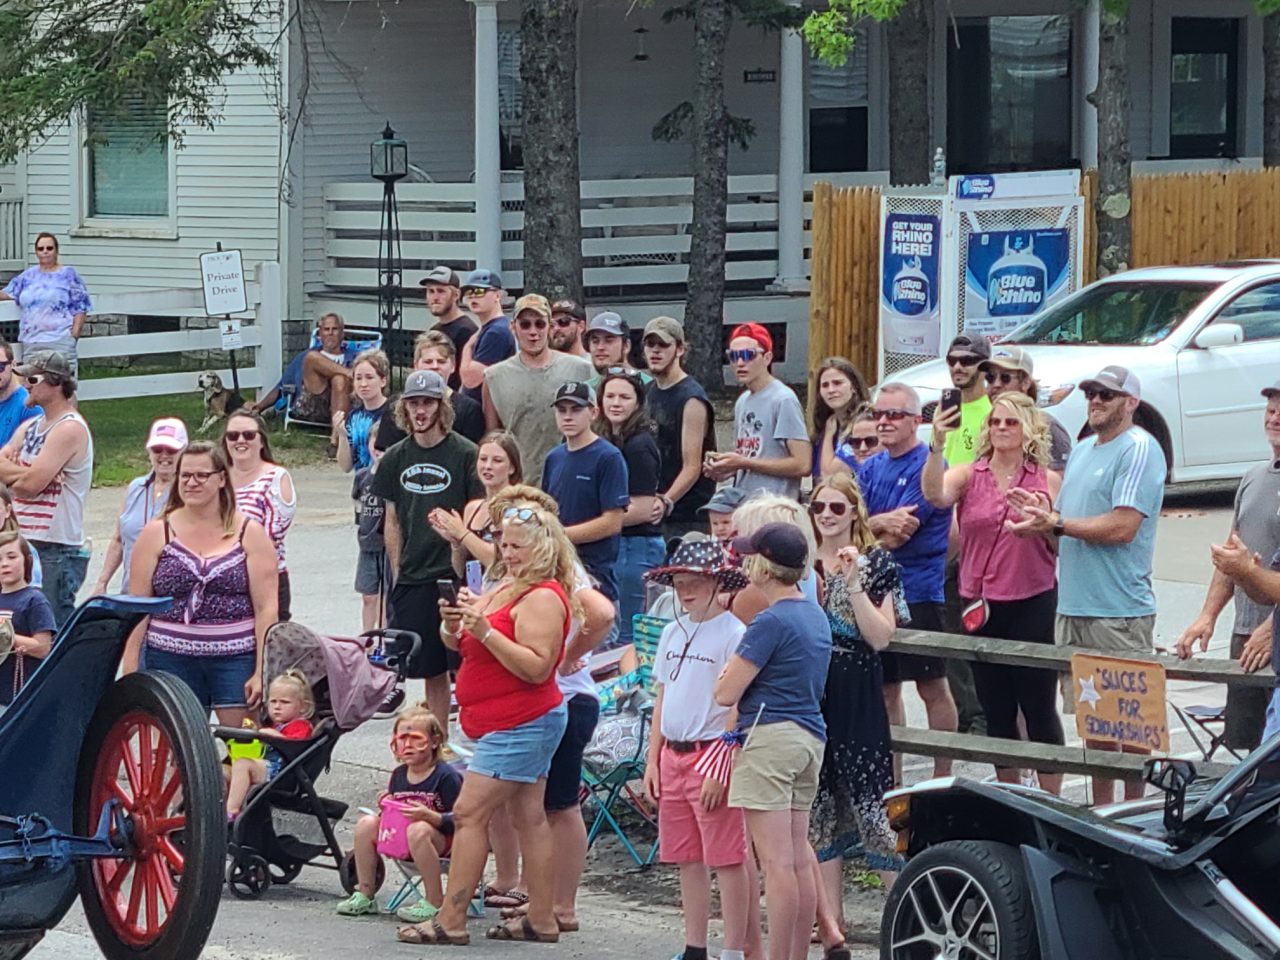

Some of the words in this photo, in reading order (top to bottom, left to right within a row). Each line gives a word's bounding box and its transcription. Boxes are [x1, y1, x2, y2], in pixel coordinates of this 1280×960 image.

[892, 221, 909, 230] GET
[910, 222, 933, 232] YOUR
[892, 230, 933, 243] RHINO
[891, 242, 932, 256] HERE!
[207, 271, 240, 282] Private
[1000, 273, 1036, 289] Blue
[211, 285, 238, 296] Drive
[900, 279, 922, 289] Blue
[897, 289, 926, 301] Rhino
[995, 288, 1042, 305] Rhino
[666, 650, 716, 664] Chapion
[1118, 698, 1143, 722] FOR
